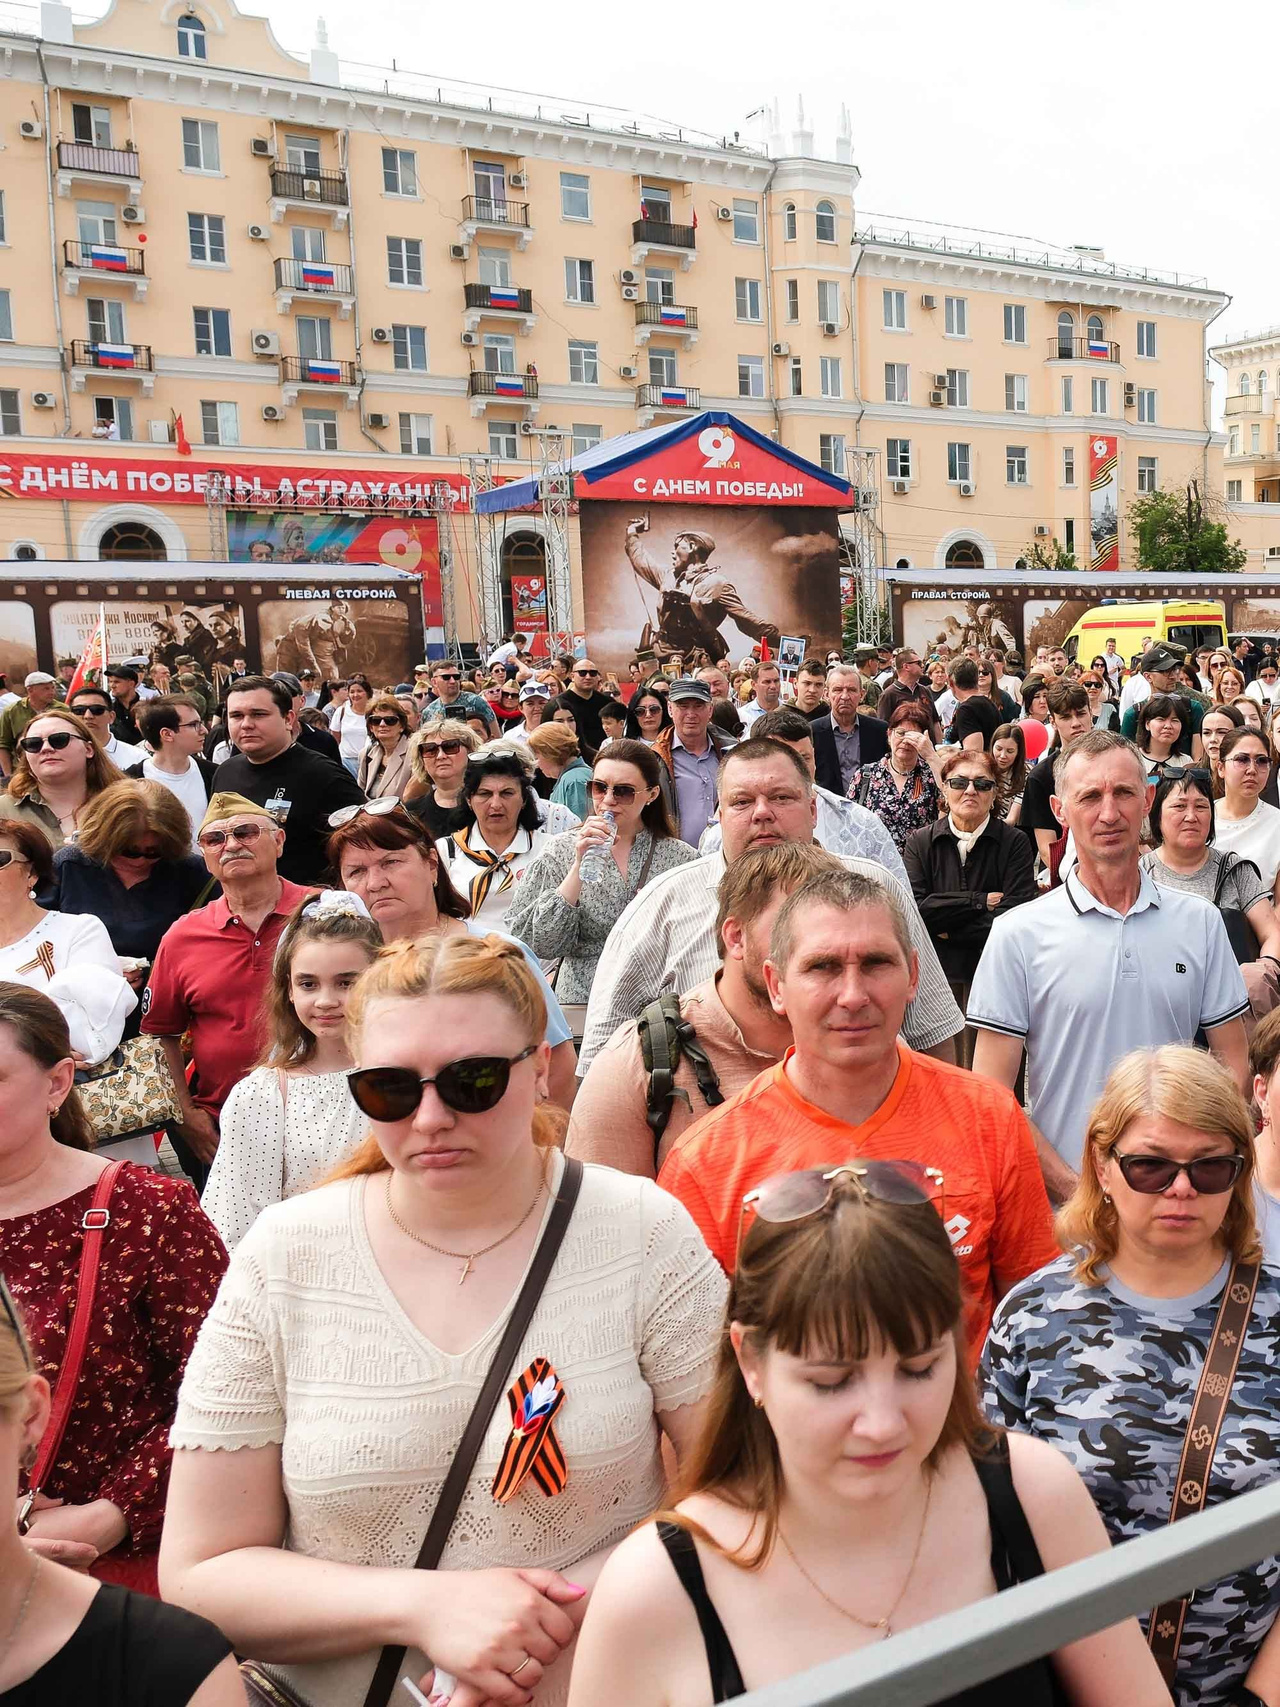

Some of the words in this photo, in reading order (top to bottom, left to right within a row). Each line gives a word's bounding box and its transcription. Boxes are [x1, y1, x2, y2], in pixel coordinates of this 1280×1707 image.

[698, 427, 735, 468] 9
[718, 460, 740, 470] МАЯ
[20, 462, 118, 491] ДНЁМ
[633, 478, 648, 493] С
[653, 479, 711, 496] ДНЕМ
[716, 481, 804, 499] ПОБЕДЫ!
[286, 589, 330, 599] ЛЕВАЯ
[336, 588, 397, 598] СТОРОНА
[911, 590, 947, 599] ПРАВАЯ
[950, 591, 991, 599] СТОРОНА
